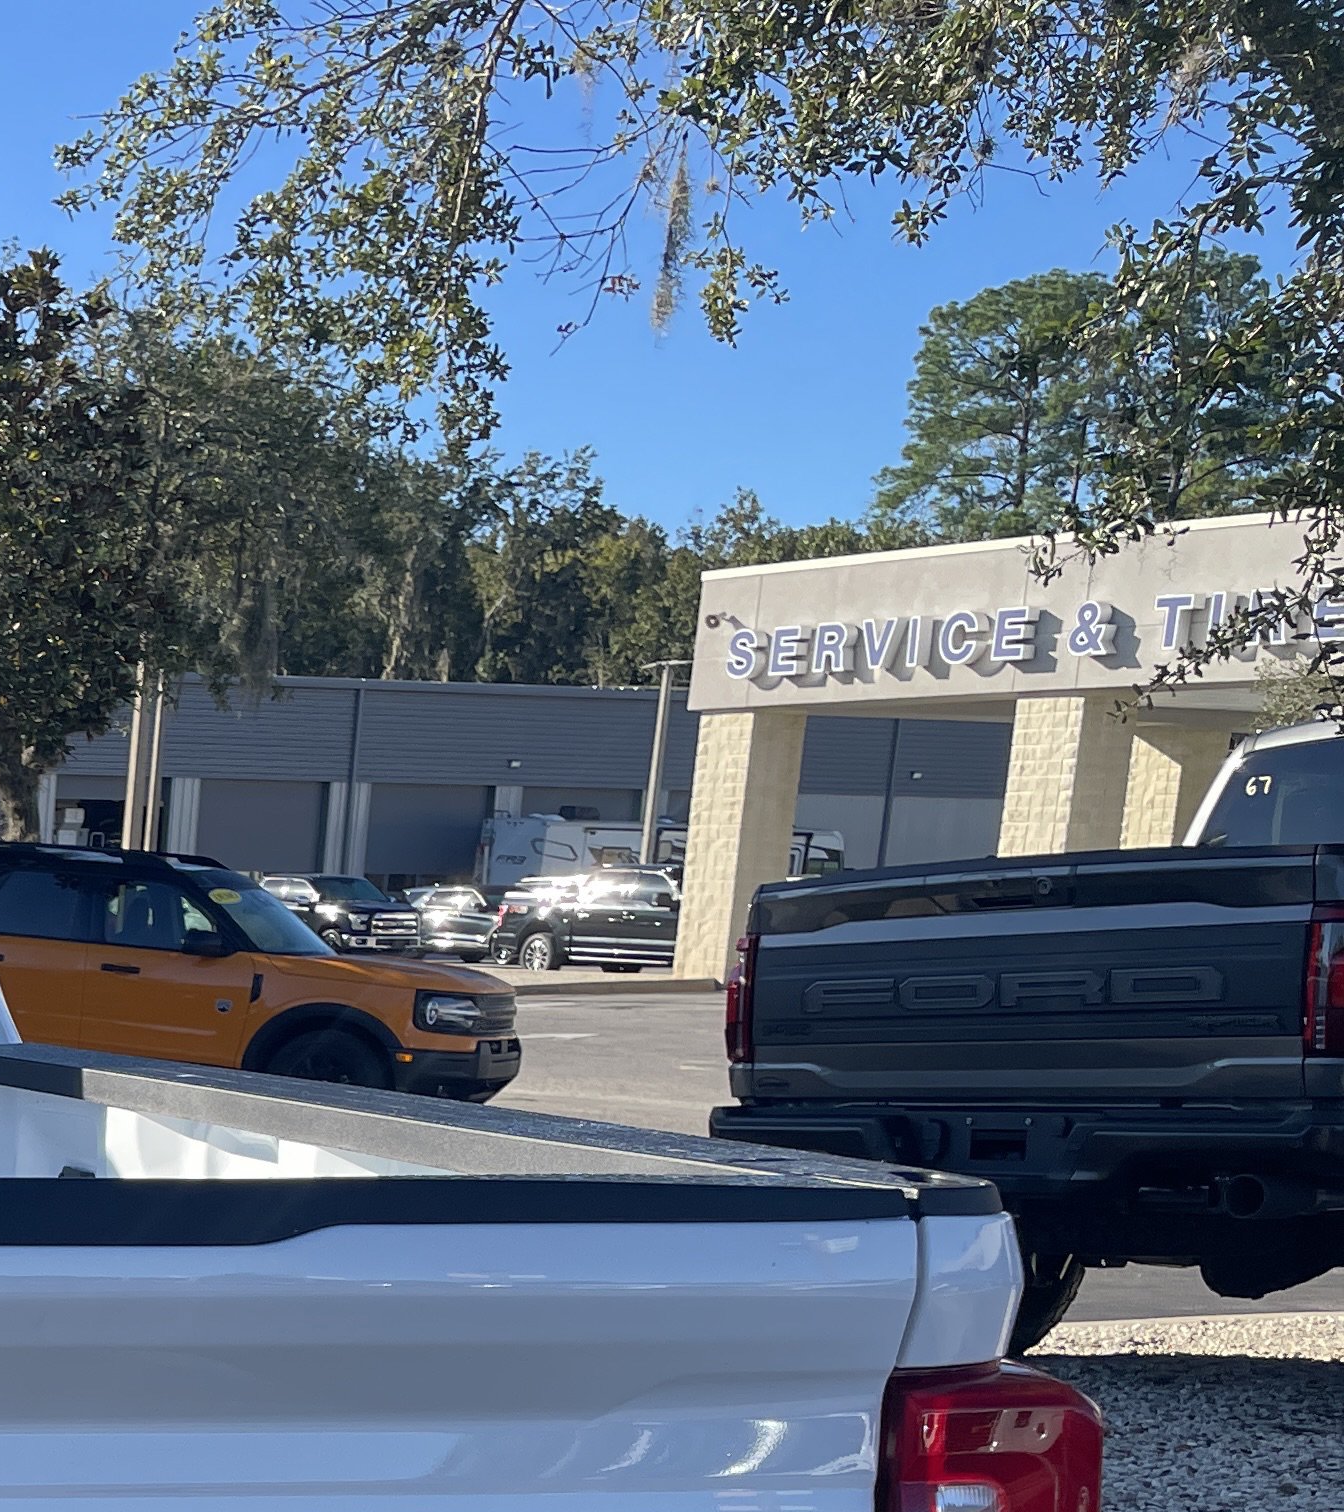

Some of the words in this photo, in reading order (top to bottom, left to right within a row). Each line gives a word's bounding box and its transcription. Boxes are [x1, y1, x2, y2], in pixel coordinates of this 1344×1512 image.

[726, 606, 1030, 680] SERVICE
[1067, 599, 1107, 657] &
[1245, 775, 1272, 796] 67
[803, 966, 1223, 1013] FORD
